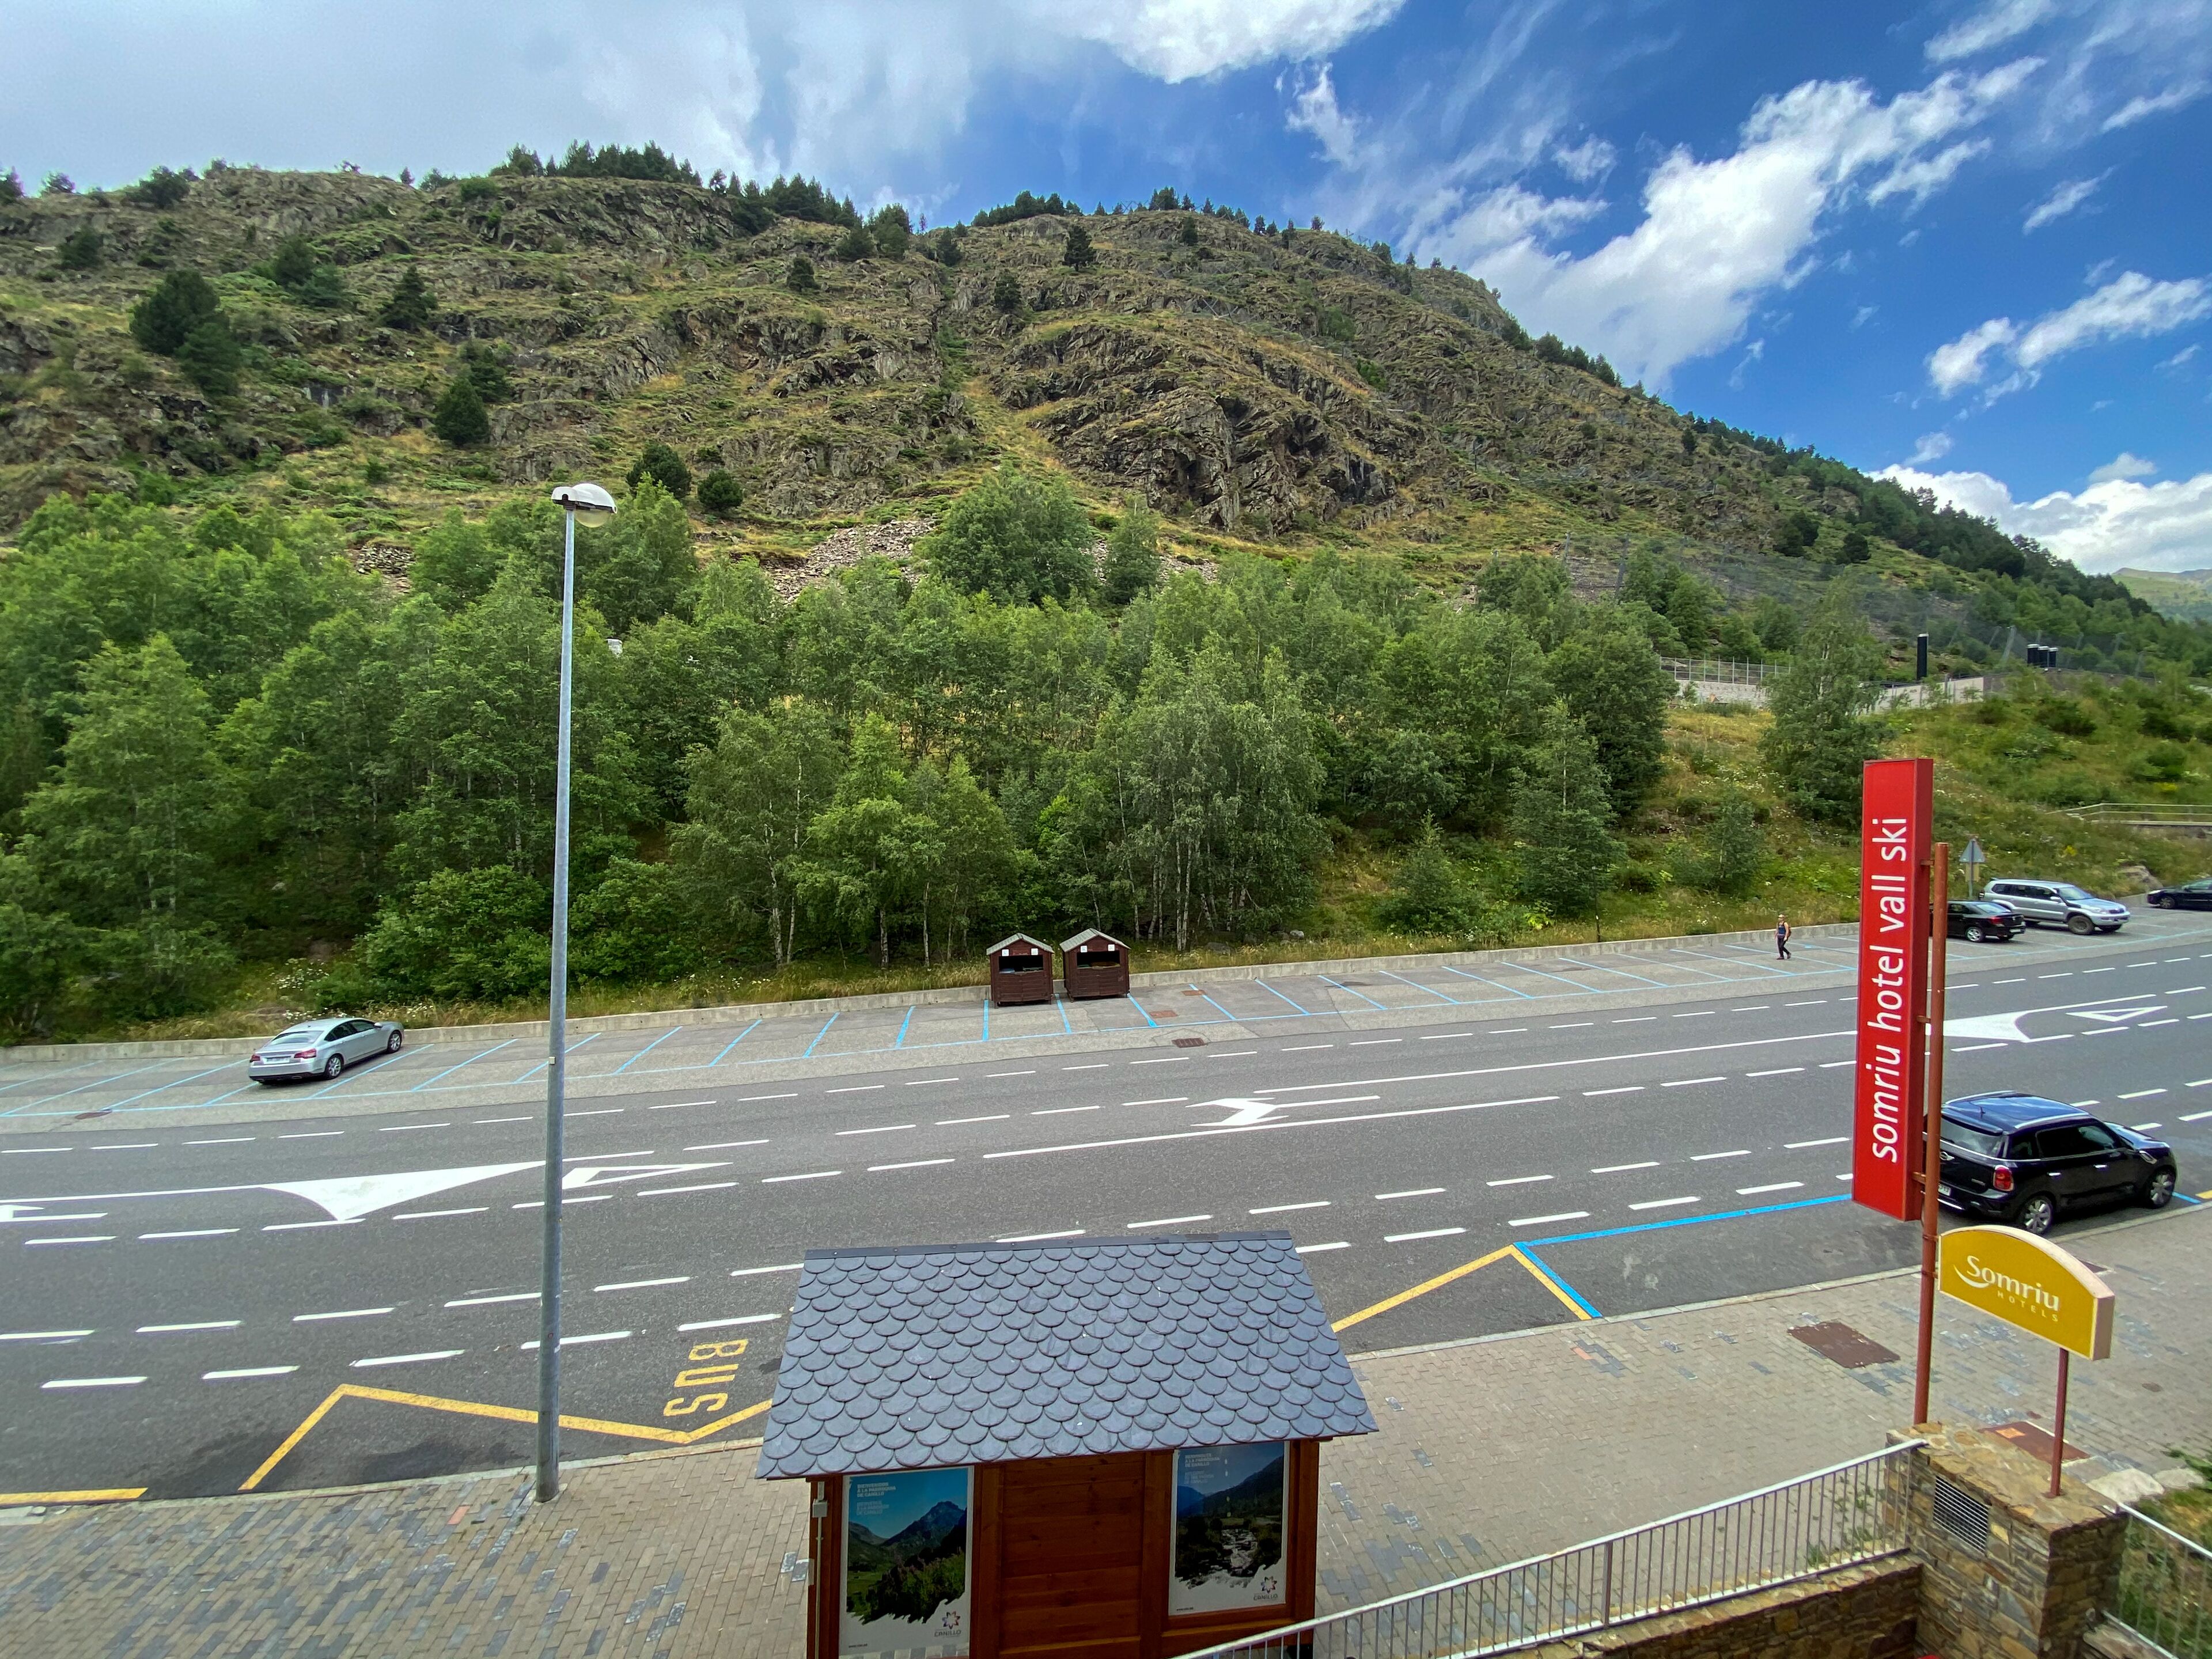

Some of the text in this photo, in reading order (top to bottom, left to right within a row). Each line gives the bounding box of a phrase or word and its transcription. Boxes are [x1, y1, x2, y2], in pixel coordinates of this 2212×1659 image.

[1865, 818, 1907, 1163] somriu hotel vall ski
[1966, 1255, 2059, 1312] Somriu
[1997, 1290, 2059, 1322] HOTELS
[663, 1339, 749, 1416] BUS
